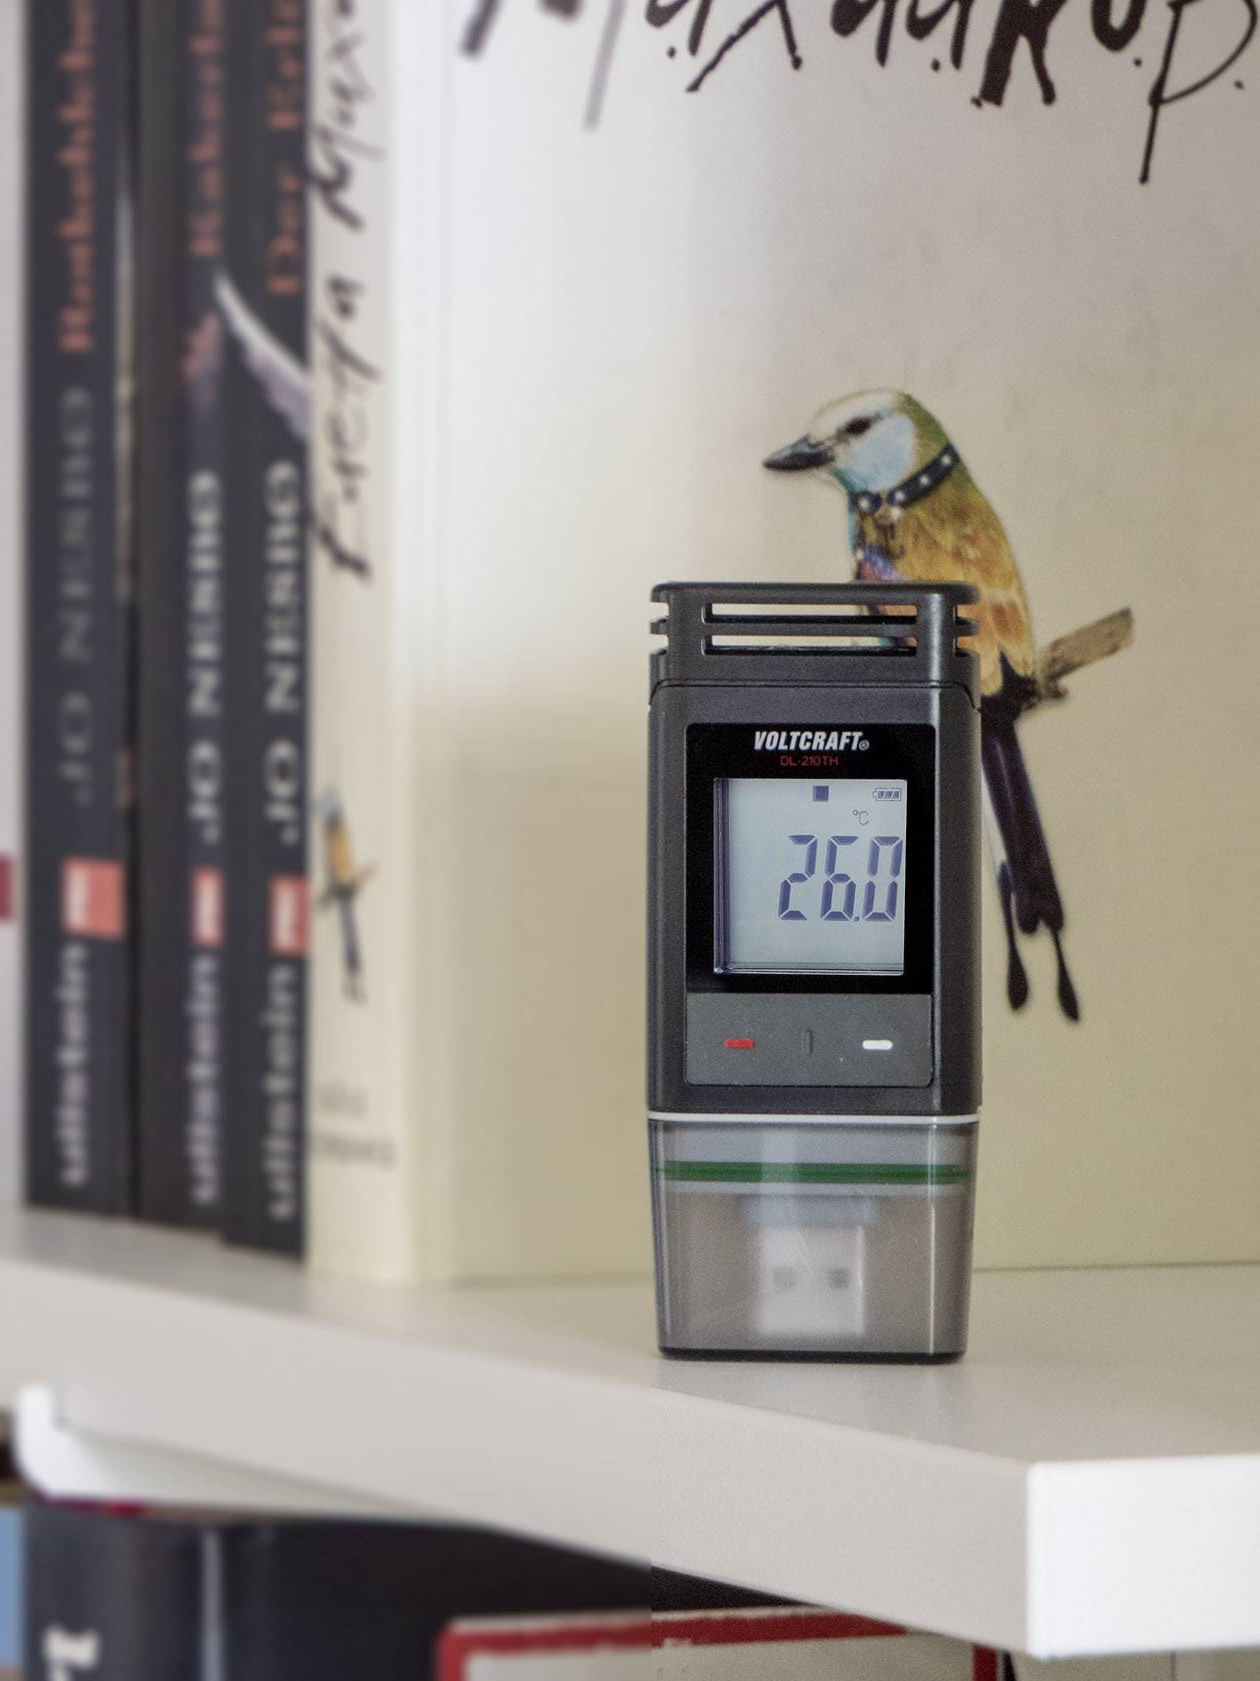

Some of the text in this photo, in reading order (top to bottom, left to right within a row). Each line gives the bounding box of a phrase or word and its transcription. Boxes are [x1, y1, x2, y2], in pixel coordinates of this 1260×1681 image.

[56, 691, 93, 808] JO
[187, 739, 223, 846] JO
[264, 739, 300, 846] JO
[777, 834, 904, 922] 26.0
[54, 943, 90, 1188] ullstein
[185, 955, 220, 1204] ullstein
[263, 965, 298, 1222] ullstein
